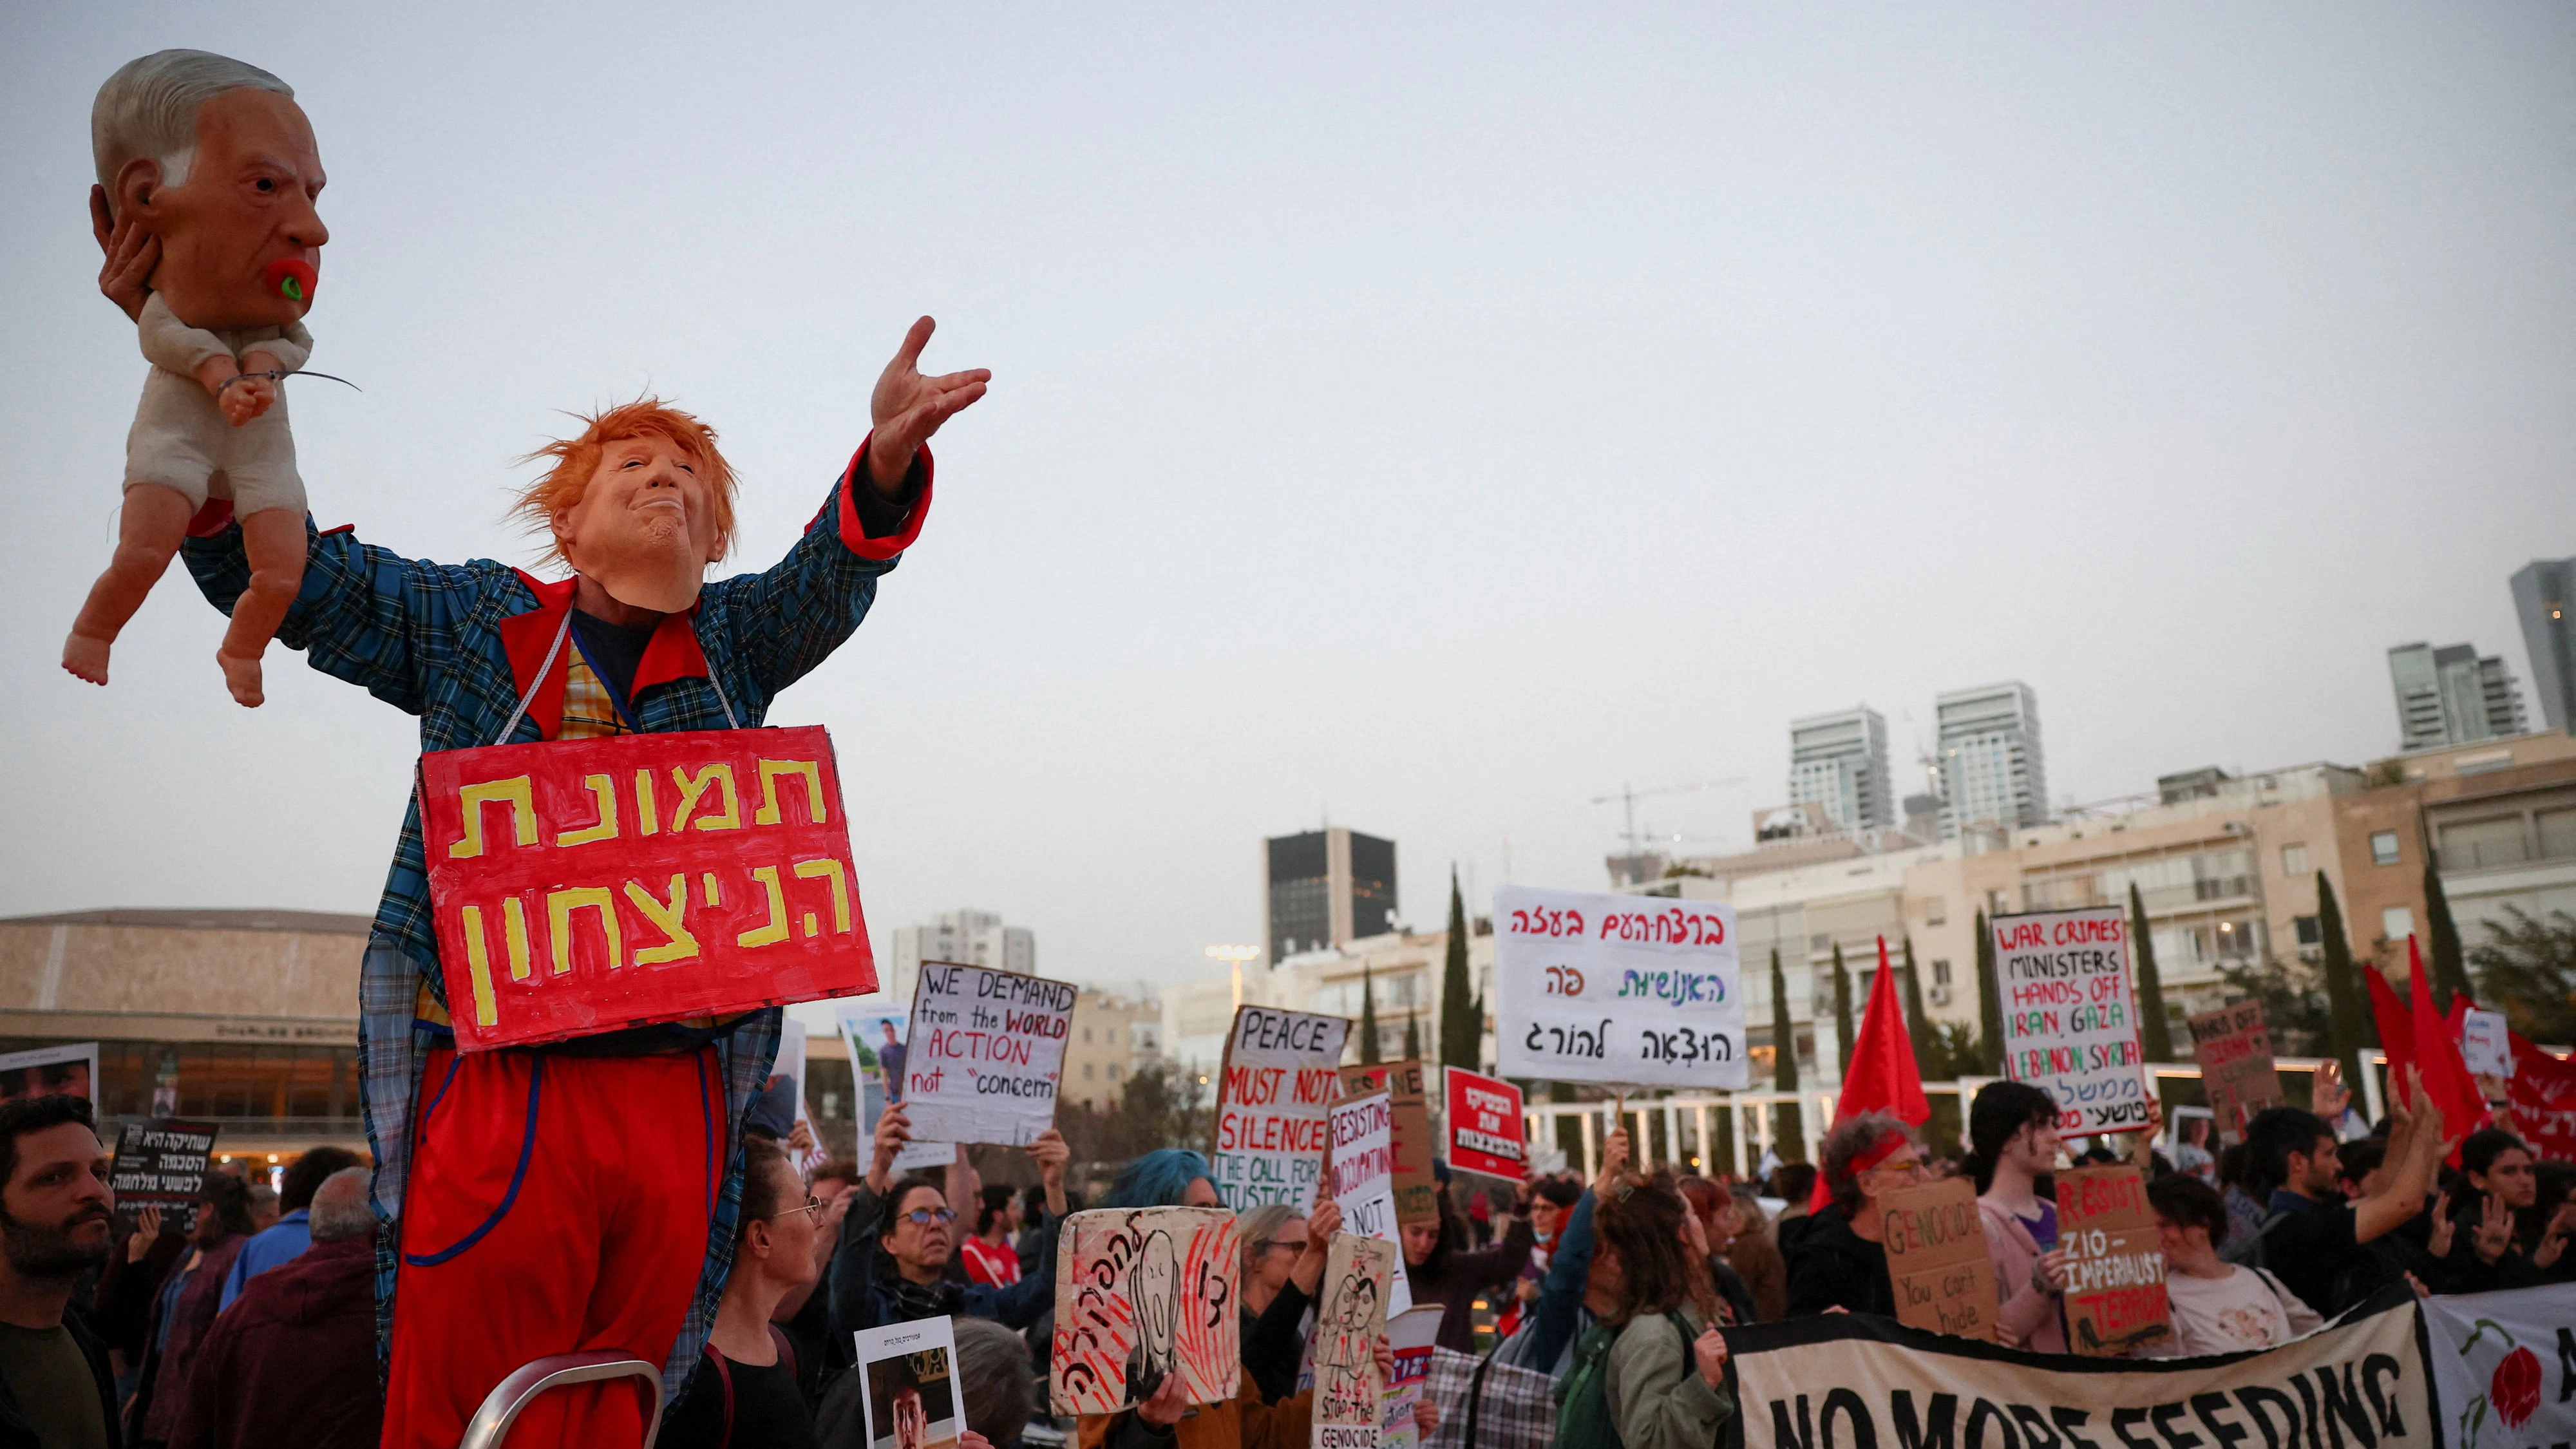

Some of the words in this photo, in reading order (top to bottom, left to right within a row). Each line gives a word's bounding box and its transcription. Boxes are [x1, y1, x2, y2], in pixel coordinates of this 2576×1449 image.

[449, 759, 827, 859] תמונת
[1511, 905, 1584, 937] בעזה
[1998, 922, 2047, 951] WAR
[2054, 919, 2121, 947] CRIMES
[461, 858, 851, 1027] הניצחון
[2010, 950, 2119, 980] MINISTERS
[926, 968, 964, 996] WE
[978, 971, 1075, 1012] DEMAND
[2012, 978, 2083, 1007] HANDS
[2090, 975, 2121, 1002] OFF
[920, 998, 958, 1025] from
[971, 1005, 998, 1028] the
[1005, 1009, 1067, 1039] WORLD
[1242, 1010, 1329, 1052] PEACE
[2008, 1010, 2065, 1039] IRAN,
[2071, 1003, 2124, 1033] GAZA
[928, 1028, 1032, 1066] ACTION
[2090, 1041, 2138, 1071] SYRIA
[911, 1066, 944, 1093] not
[1223, 1065, 1287, 1106] MUST
[1292, 1068, 1337, 1106] NOT
[1331, 1098, 1392, 1150] RESISTING
[2085, 1101, 2149, 1126] פושעי
[142, 1131, 165, 1148] היא
[164, 1133, 212, 1152] שתיקה
[1220, 1112, 1327, 1153] SILENCE
[158, 1153, 207, 1172] הסכמה
[1215, 1152, 1245, 1181] THE
[1249, 1157, 1285, 1183] CALL
[1291, 1159, 1320, 1184] FOR
[111, 1171, 158, 1191] מלחמה
[161, 1174, 203, 1192] לפשעי
[1220, 1184, 1305, 1215] JUSTICE
[2056, 1175, 2142, 1227] RESIST
[1352, 1198, 1384, 1235] NOT
[1884, 1201, 1982, 1255] GENOCIDE
[1899, 1276, 1931, 1308] You
[1935, 1302, 1980, 1334] hide
[2075, 1283, 2170, 1337] TERROR
[1322, 1396, 1347, 1420] STOP
[1770, 1387, 1877, 1449] NO
[1891, 1390, 2102, 1449] MORE
[1321, 1428, 1379, 1449] GENOCIDE
